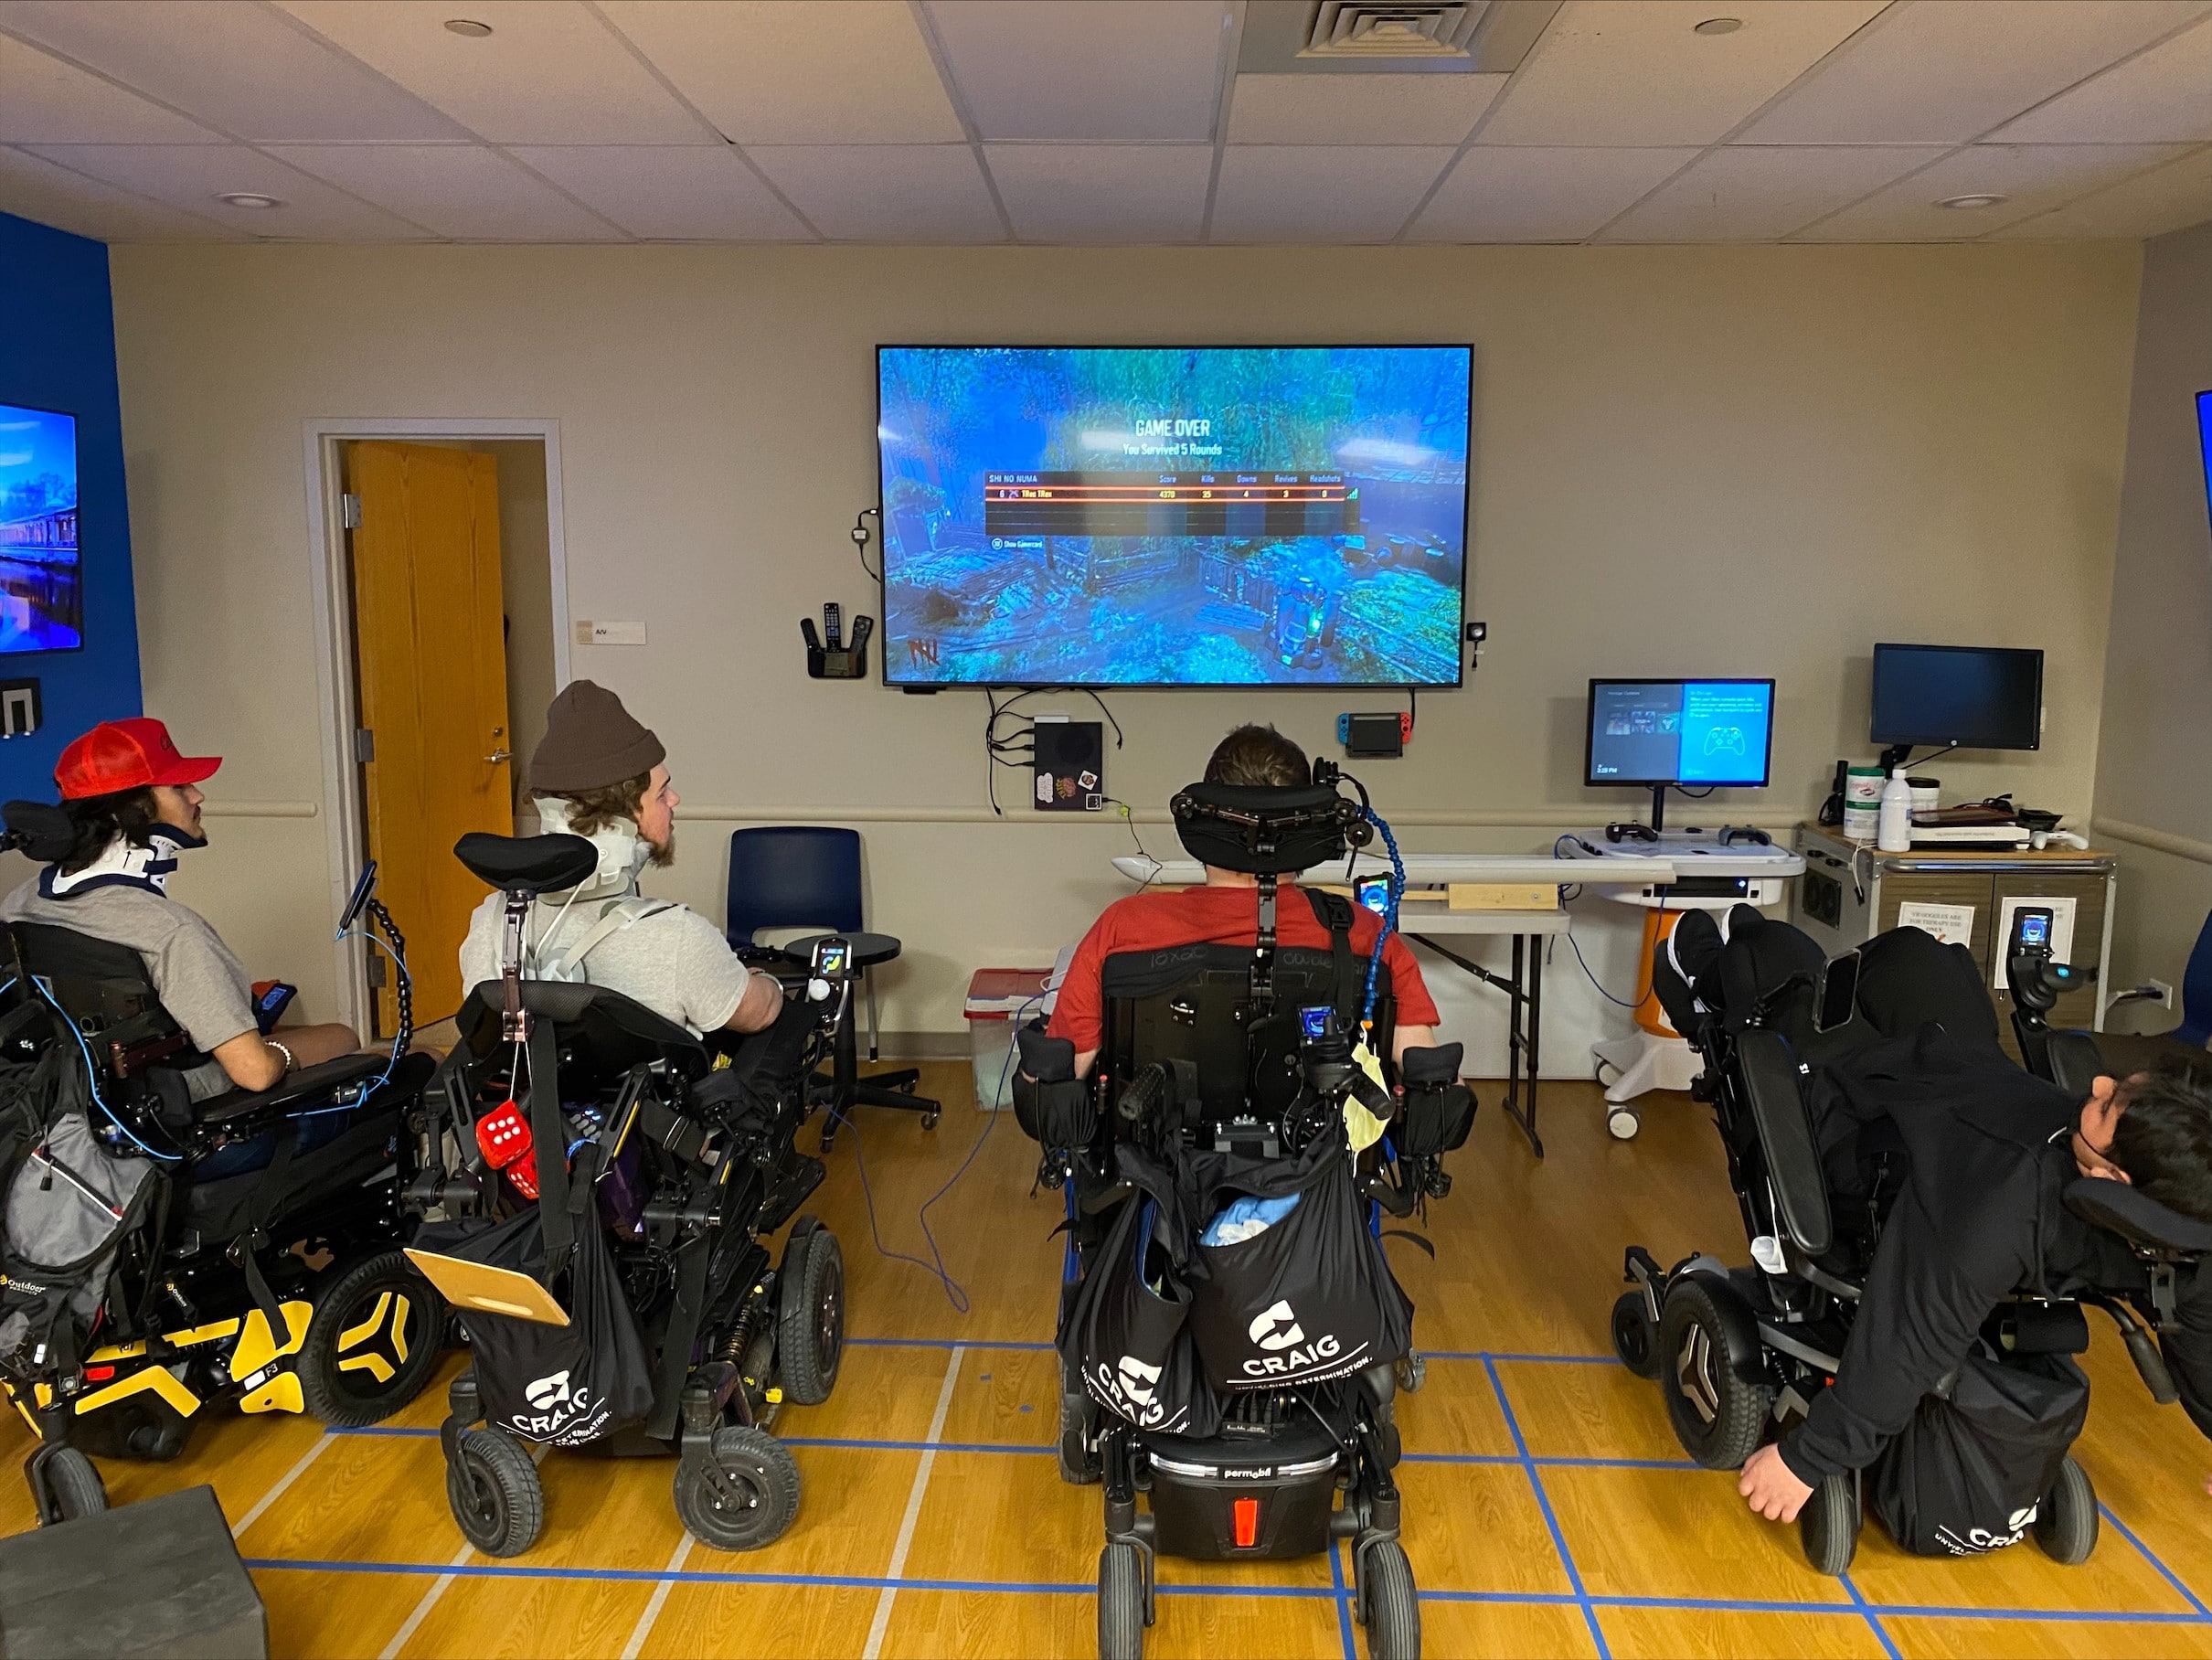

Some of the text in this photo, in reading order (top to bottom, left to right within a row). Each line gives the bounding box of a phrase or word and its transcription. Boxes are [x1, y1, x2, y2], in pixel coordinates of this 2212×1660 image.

[1135, 419, 1210, 437] GAME OVER
[1122, 443, 1222, 455] You Survived 5 Rounds
[989, 474, 1342, 484] SHI NO NUMA Score Kills Downs Revives Headshots
[1243, 490, 1250, 498] 4
[8, 1279, 46, 1293] Outdoor
[1243, 1335, 1341, 1376] CRAIG
[265, 1363, 279, 1377] F3
[1224, 1467, 1271, 1479] permobil
[1970, 1528, 2024, 1548] CRA
